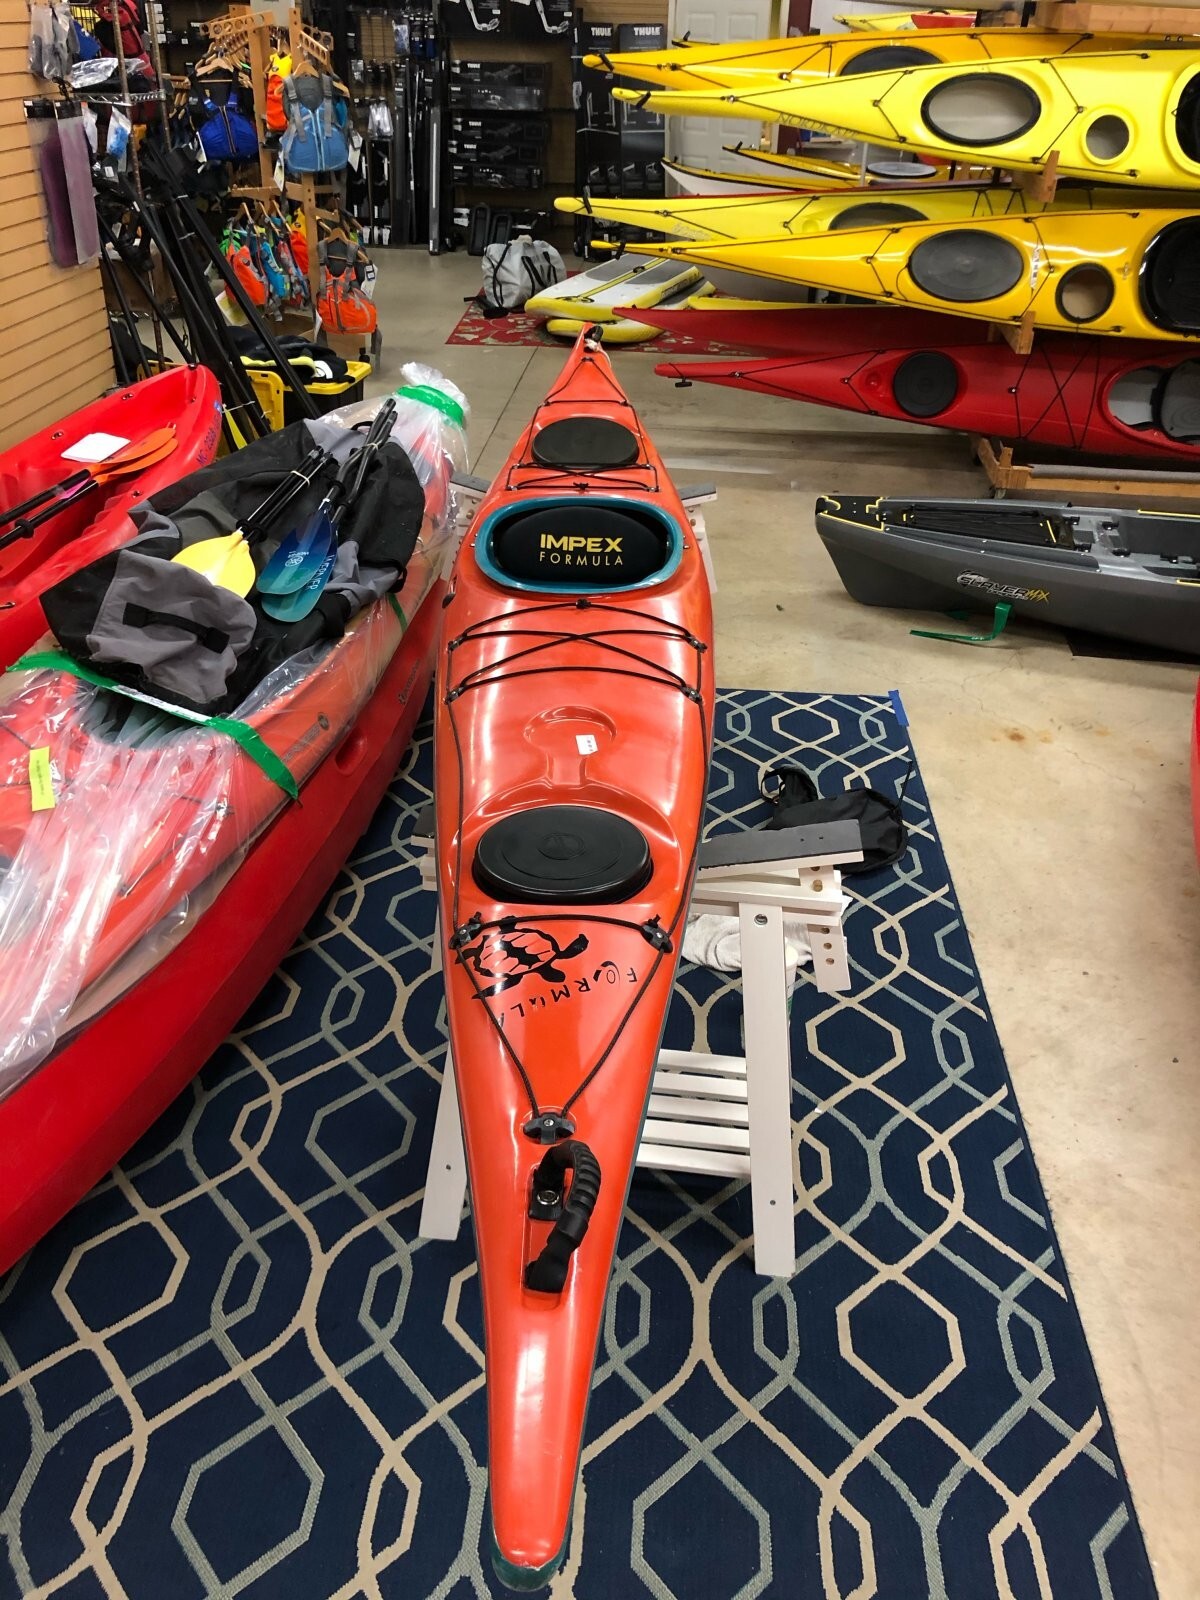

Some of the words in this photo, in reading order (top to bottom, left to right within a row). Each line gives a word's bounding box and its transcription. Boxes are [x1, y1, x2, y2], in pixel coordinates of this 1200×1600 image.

[591, 27, 612, 37] THULE
[633, 26, 661, 36] THULE
[540, 534, 623, 552] IMPEX
[539, 552, 623, 566] FORMULA
[958, 575, 1029, 598] SLAYER
